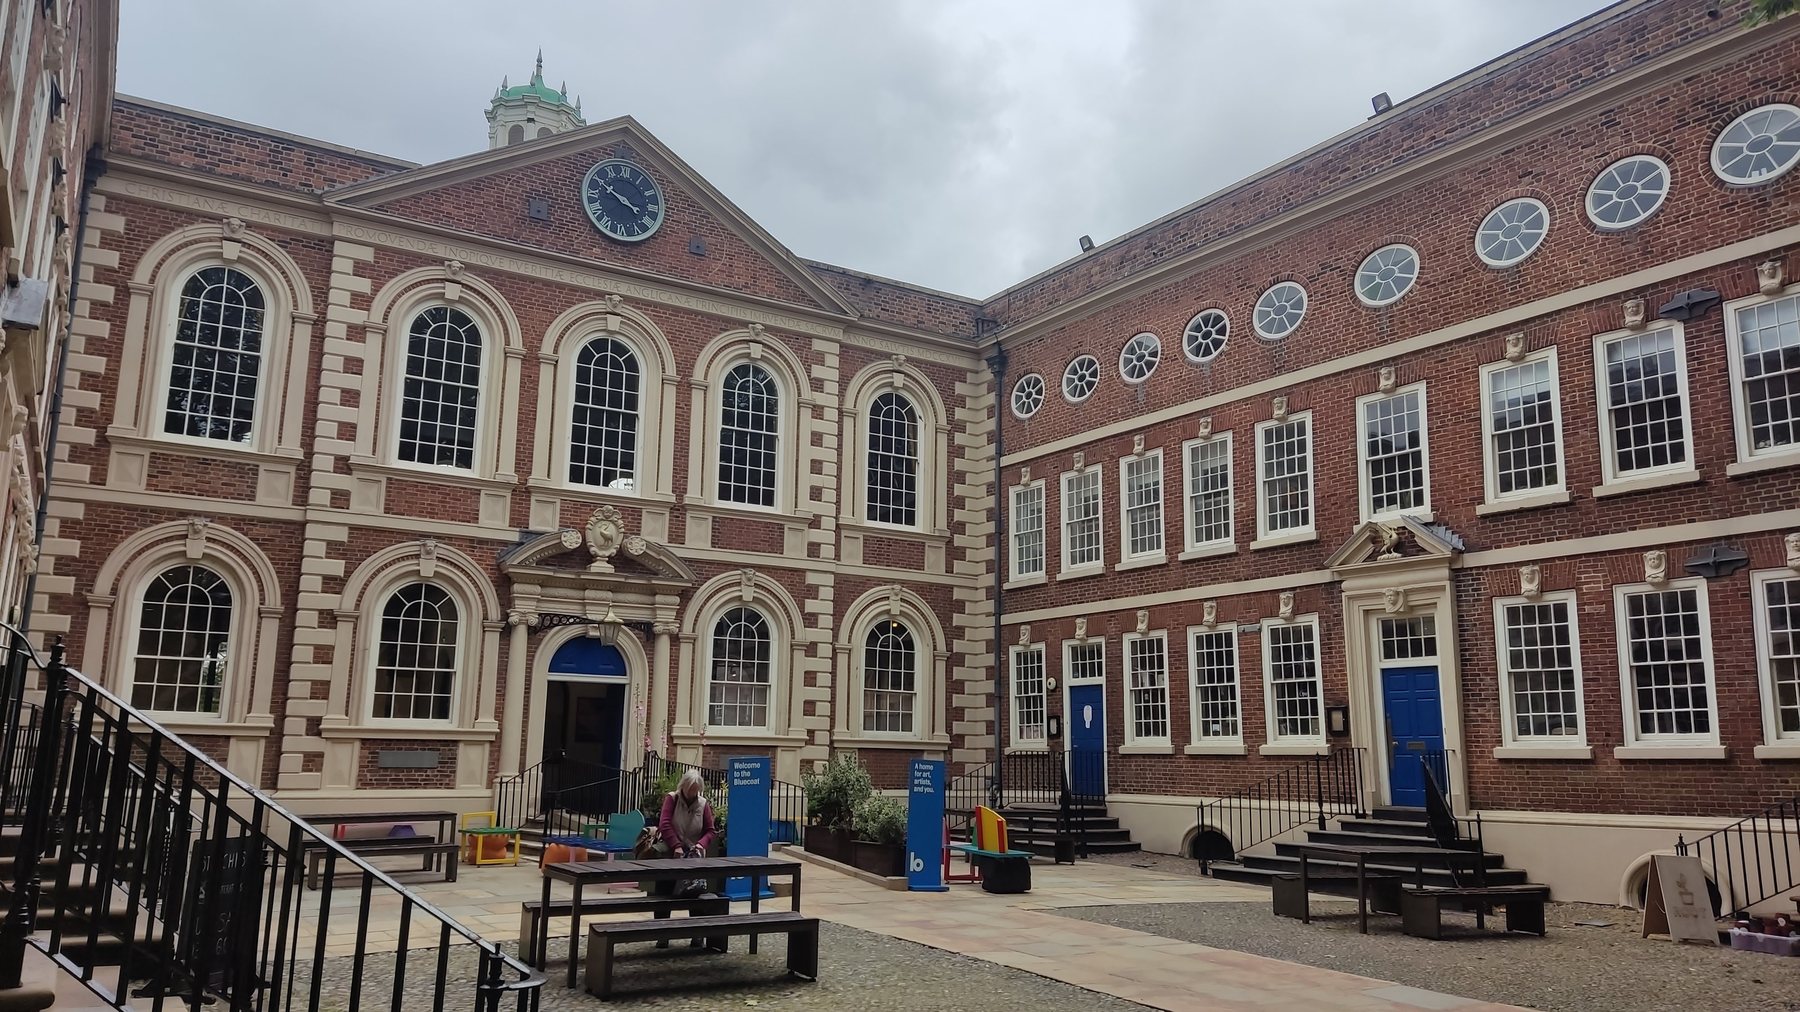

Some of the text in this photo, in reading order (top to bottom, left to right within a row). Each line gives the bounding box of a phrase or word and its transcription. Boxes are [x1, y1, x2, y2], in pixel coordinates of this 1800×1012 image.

[620, 166, 631, 178] XII
[644, 189, 655, 197] II
[590, 200, 602, 217] VIII
[647, 203, 658, 213] III
[600, 215, 612, 230] VII
[616, 224, 627, 236] VI
[633, 223, 642, 235] V
[734, 778, 760, 786] Bluecoat
[914, 778, 931, 786] artists,
